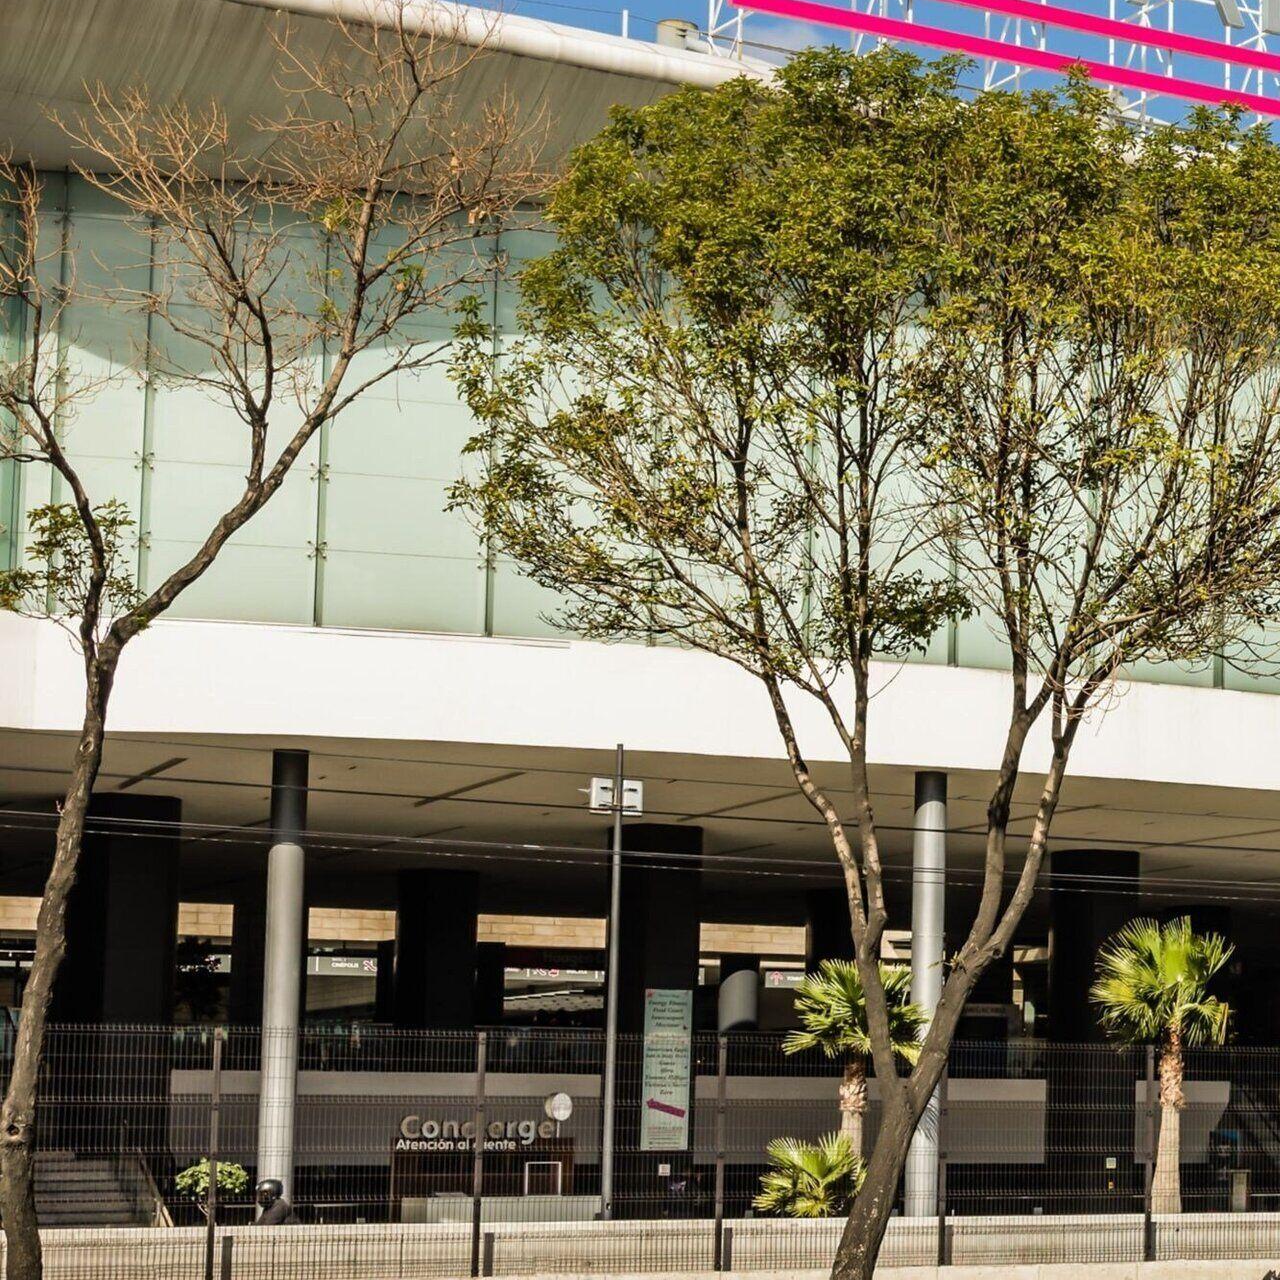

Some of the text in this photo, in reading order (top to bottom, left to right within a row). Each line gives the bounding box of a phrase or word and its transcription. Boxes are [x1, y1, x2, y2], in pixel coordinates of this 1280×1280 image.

[400, 1115, 556, 1145] Concerge
[396, 1138, 451, 1151] Atención
[457, 1138, 469, 1150] al
